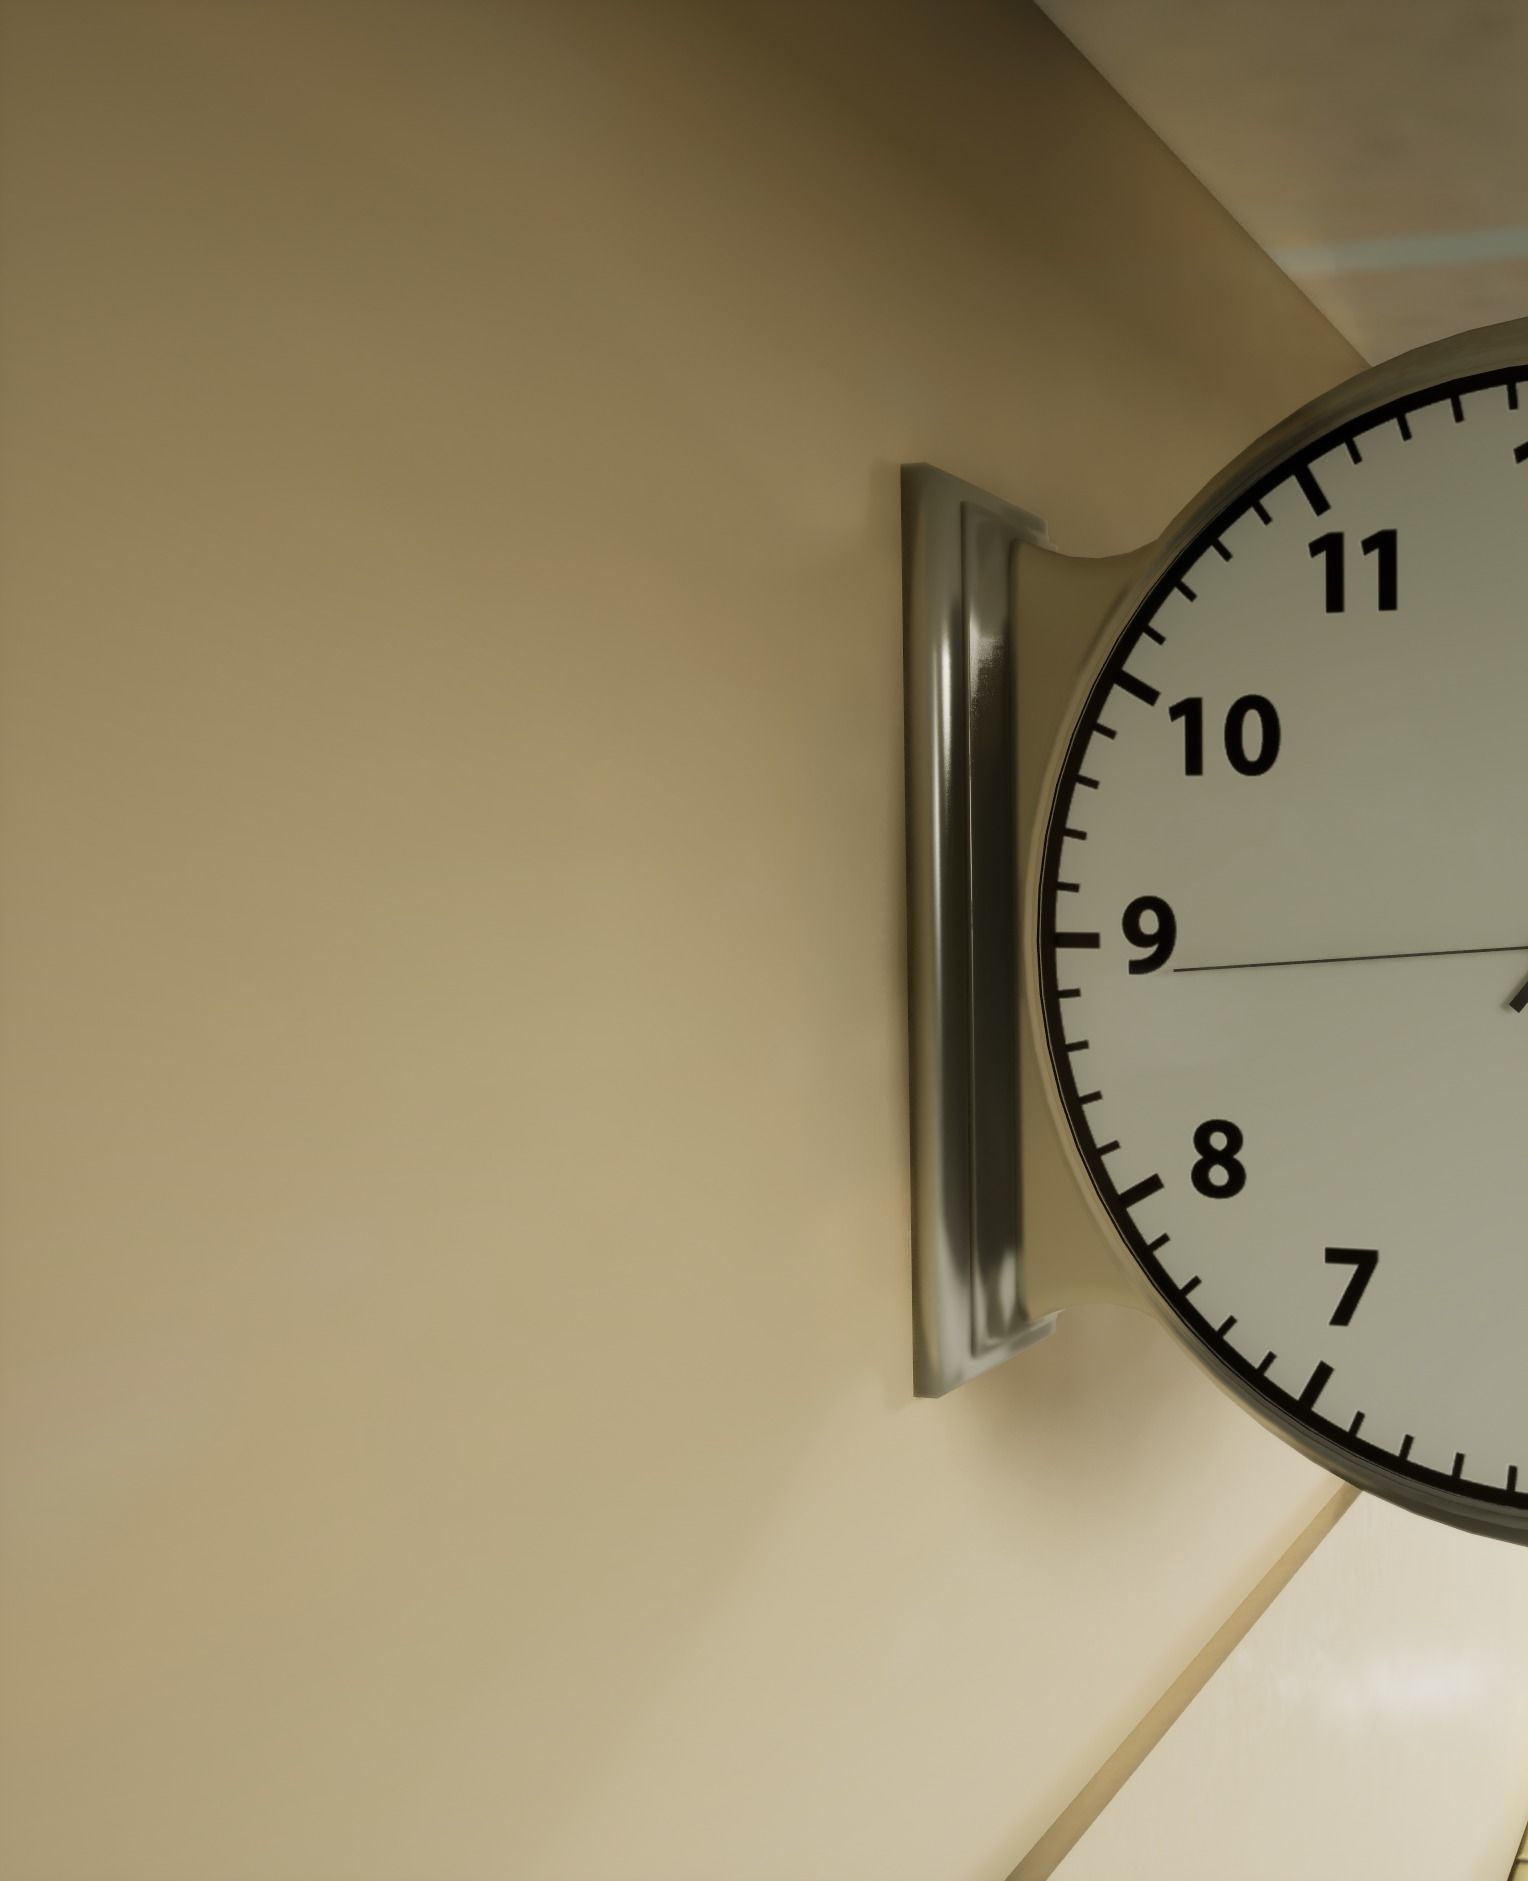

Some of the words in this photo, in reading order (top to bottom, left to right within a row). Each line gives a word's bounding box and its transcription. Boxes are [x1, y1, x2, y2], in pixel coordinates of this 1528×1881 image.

[1308, 528, 1398, 614] 11
[1168, 694, 1282, 778] 10
[1121, 895, 1178, 976] 9
[1190, 1118, 1247, 1200] 8
[1323, 1247, 1380, 1328] 7
